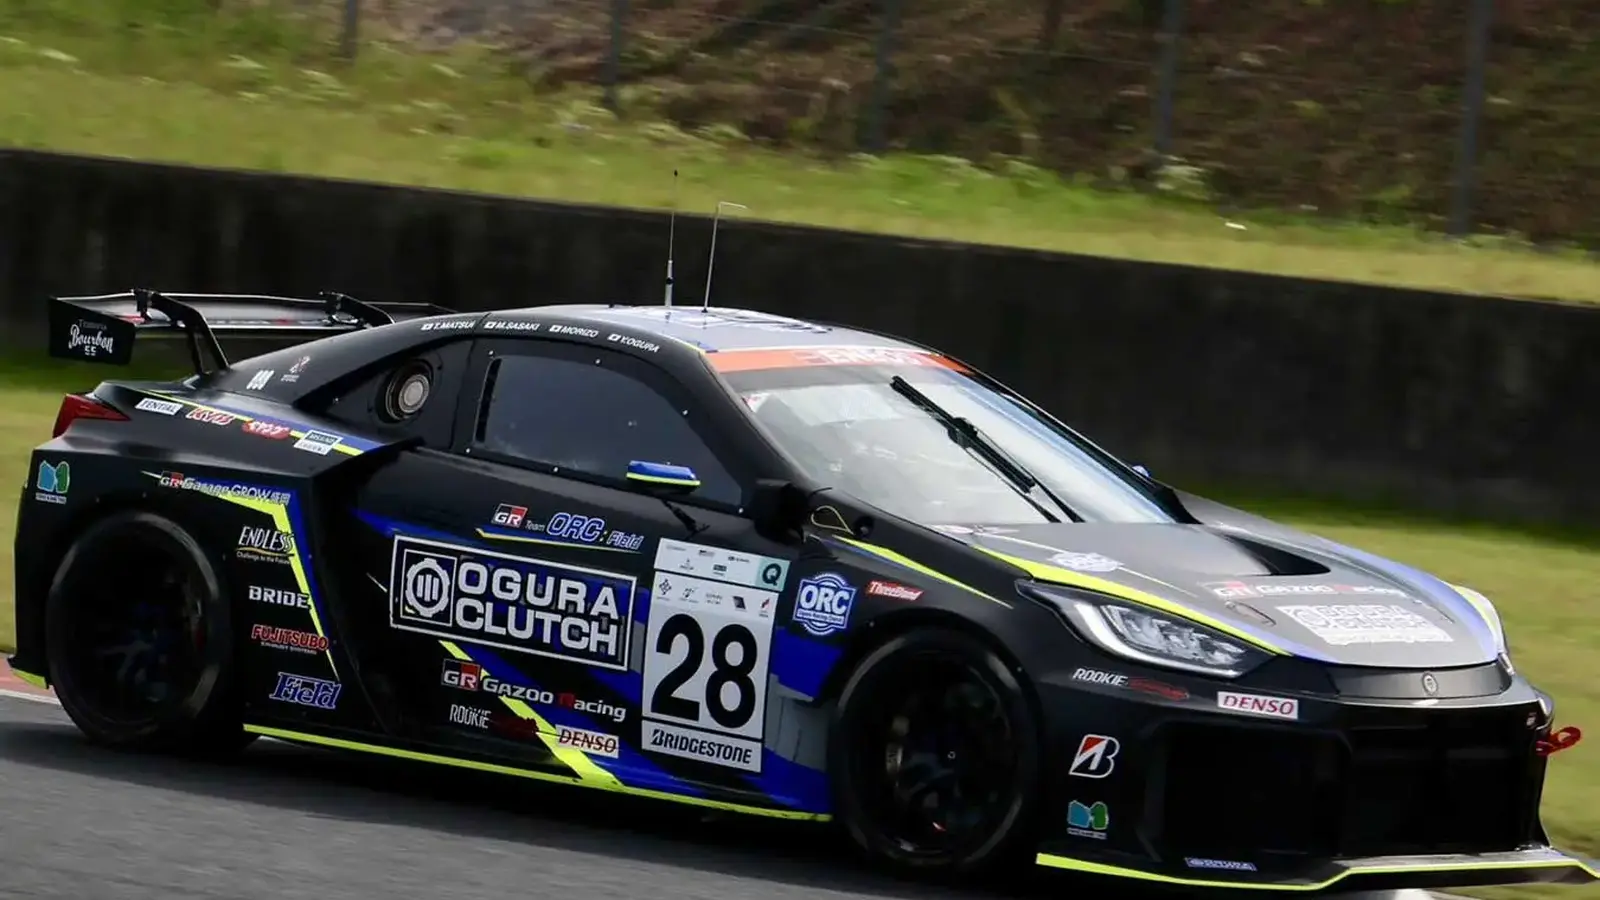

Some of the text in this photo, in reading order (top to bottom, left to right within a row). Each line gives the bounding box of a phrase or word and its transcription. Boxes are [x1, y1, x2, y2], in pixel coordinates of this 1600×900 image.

[68, 324, 114, 354] Bourbon
[495, 321, 541, 332] M.SASAKI
[560, 326, 600, 339] MORIZO
[84, 345, 97, 356] 55
[238, 526, 294, 552] ENDLESS
[494, 512, 522, 527] GR
[606, 531, 645, 550] Field
[761, 563, 782, 586] Q
[248, 585, 310, 609] BRIDE
[457, 562, 619, 620] OGURA
[800, 584, 850, 615] ORC
[251, 624, 329, 651] FUJITSUBO
[455, 597, 618, 656] CLUTCH
[443, 670, 478, 690] GR
[651, 613, 758, 729] 28
[1072, 667, 1129, 687] ROOKIE
[449, 704, 492, 729] ROOKIE
[1222, 694, 1296, 716] DENSO
[558, 728, 618, 754] DENSO
[651, 729, 753, 765] BRIDGESTONE
